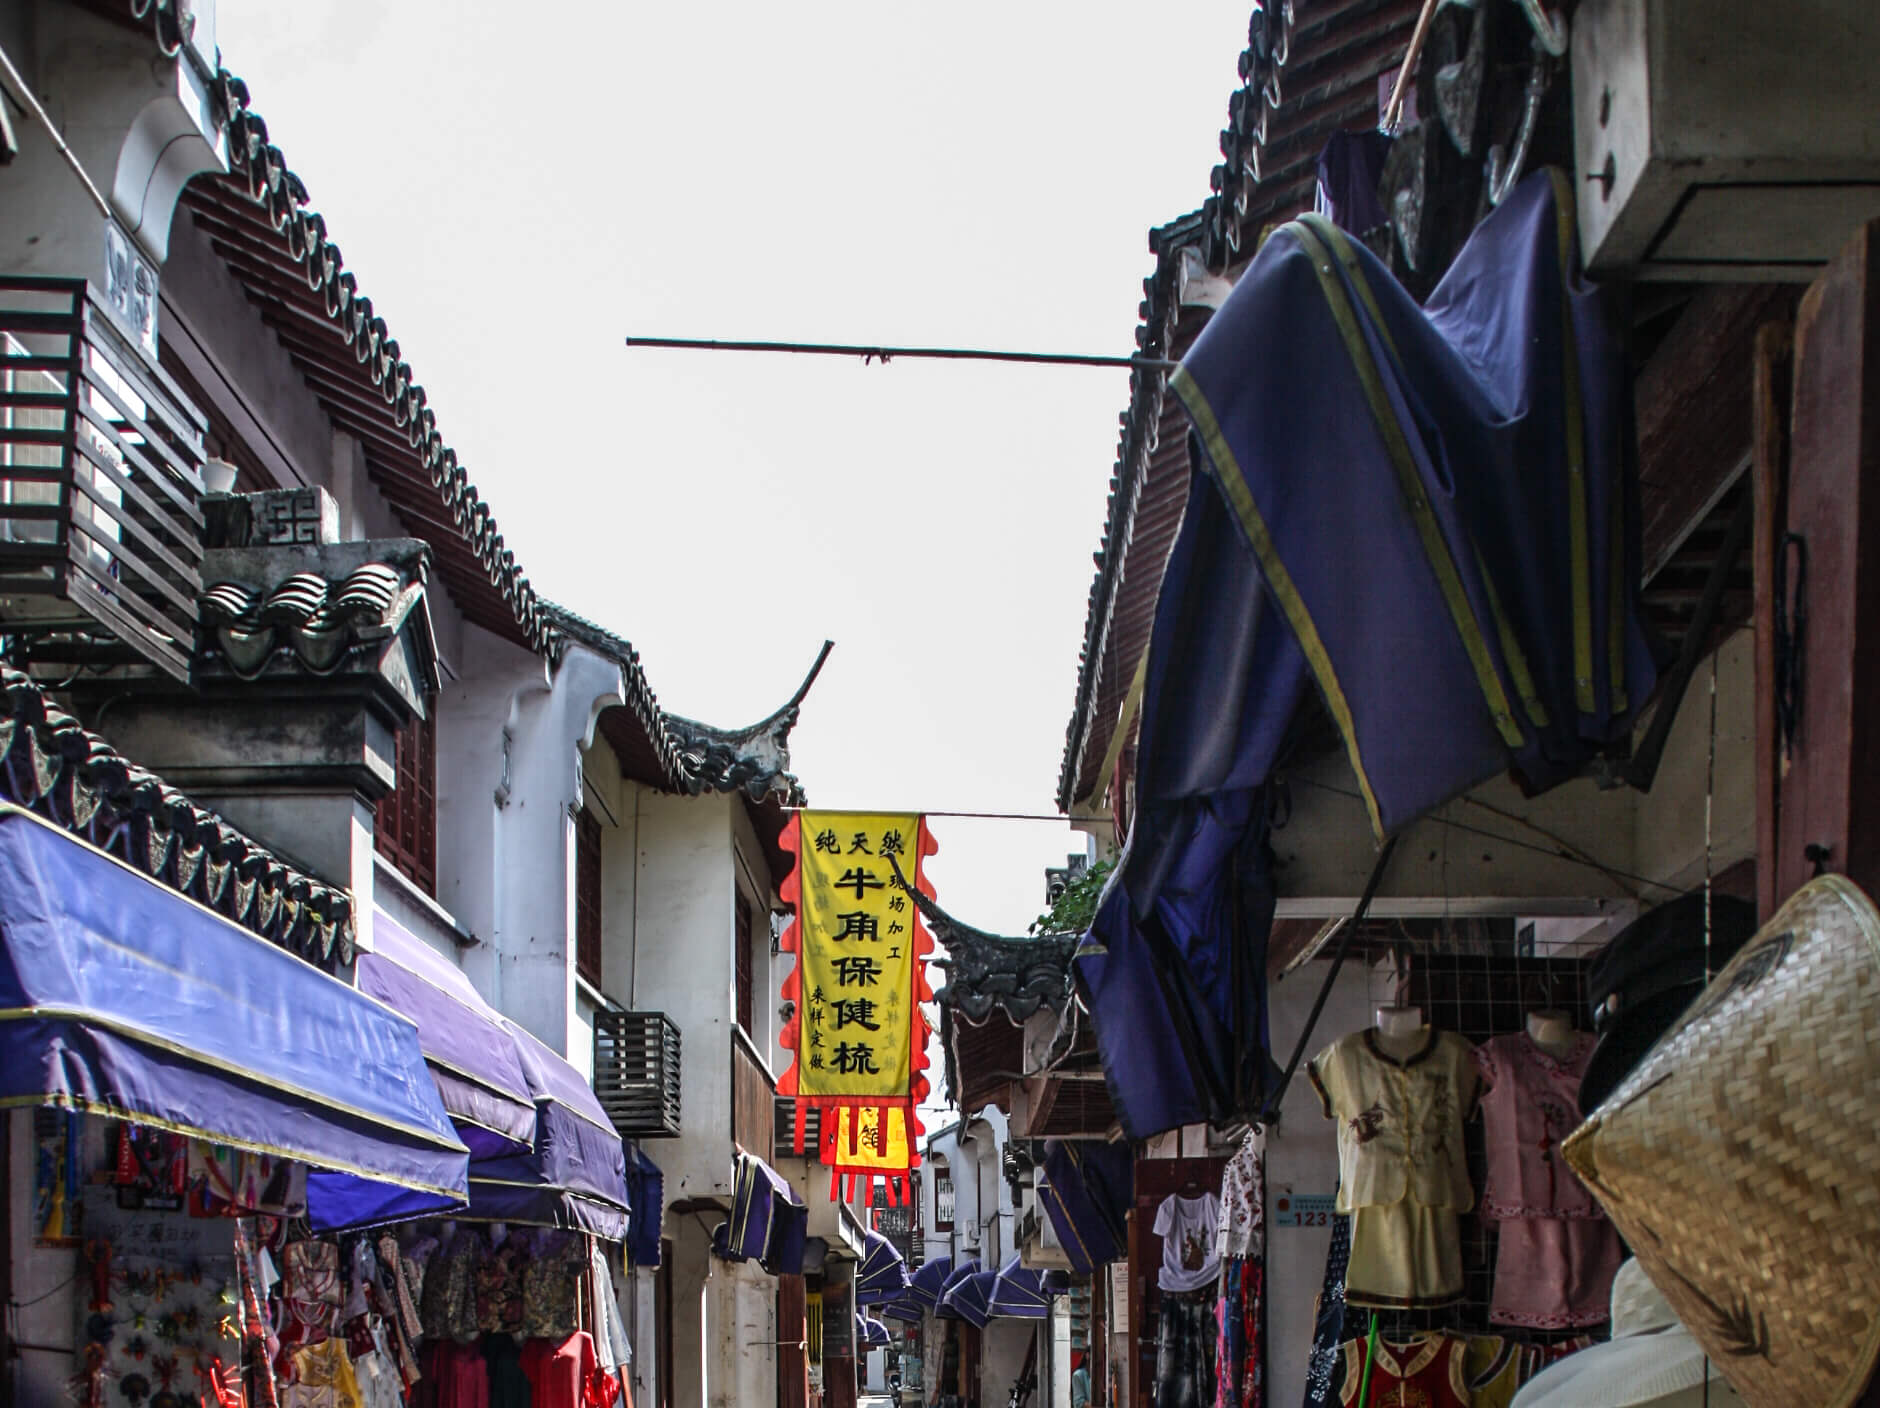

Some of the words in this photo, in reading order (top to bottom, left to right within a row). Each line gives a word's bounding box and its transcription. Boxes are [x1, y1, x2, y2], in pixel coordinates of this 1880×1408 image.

[815, 828, 904, 856] 纯天然
[886, 874, 906, 959] 现场加工
[829, 867, 886, 1075] 牛角保健梳
[809, 985, 826, 1070] 来样定做
